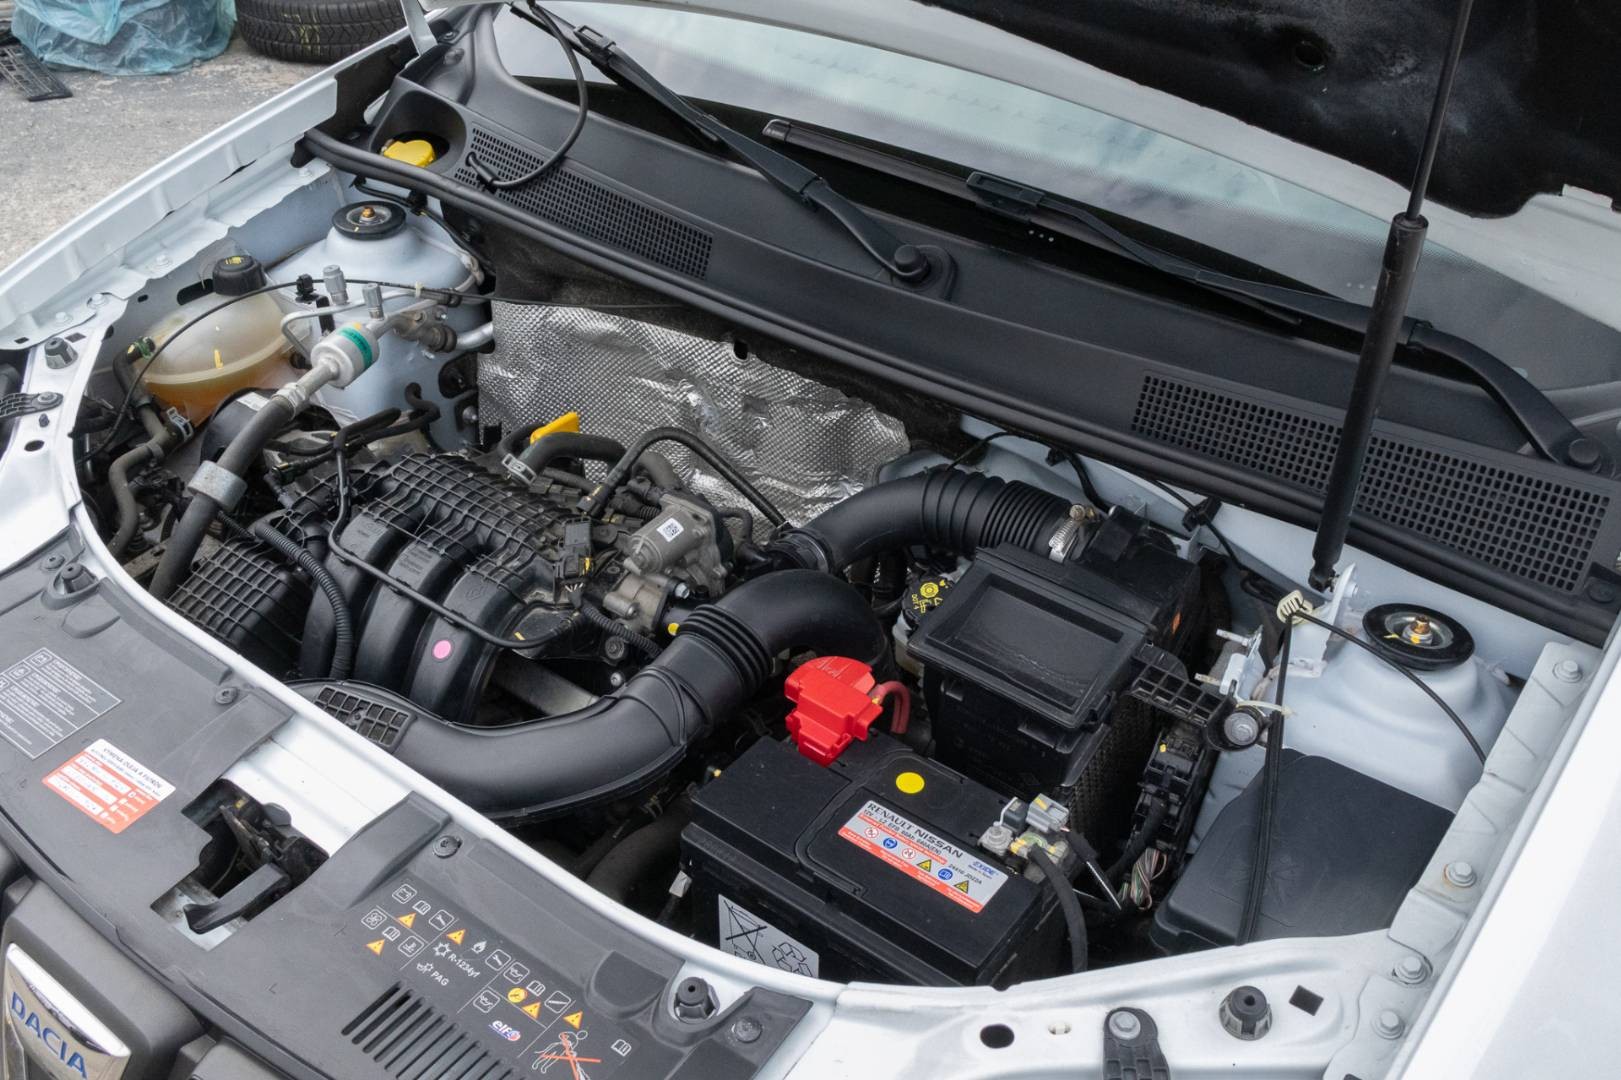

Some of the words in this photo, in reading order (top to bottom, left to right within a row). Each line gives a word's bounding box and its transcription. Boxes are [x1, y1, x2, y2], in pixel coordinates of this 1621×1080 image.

[867, 803, 913, 830] RENAULT
[915, 829, 963, 858] NISSAN
[973, 861, 995, 875] EXIDE
[430, 970, 450, 986] PAG
[448, 953, 481, 978] R-1234yf
[12, 991, 87, 1079] DACIA
